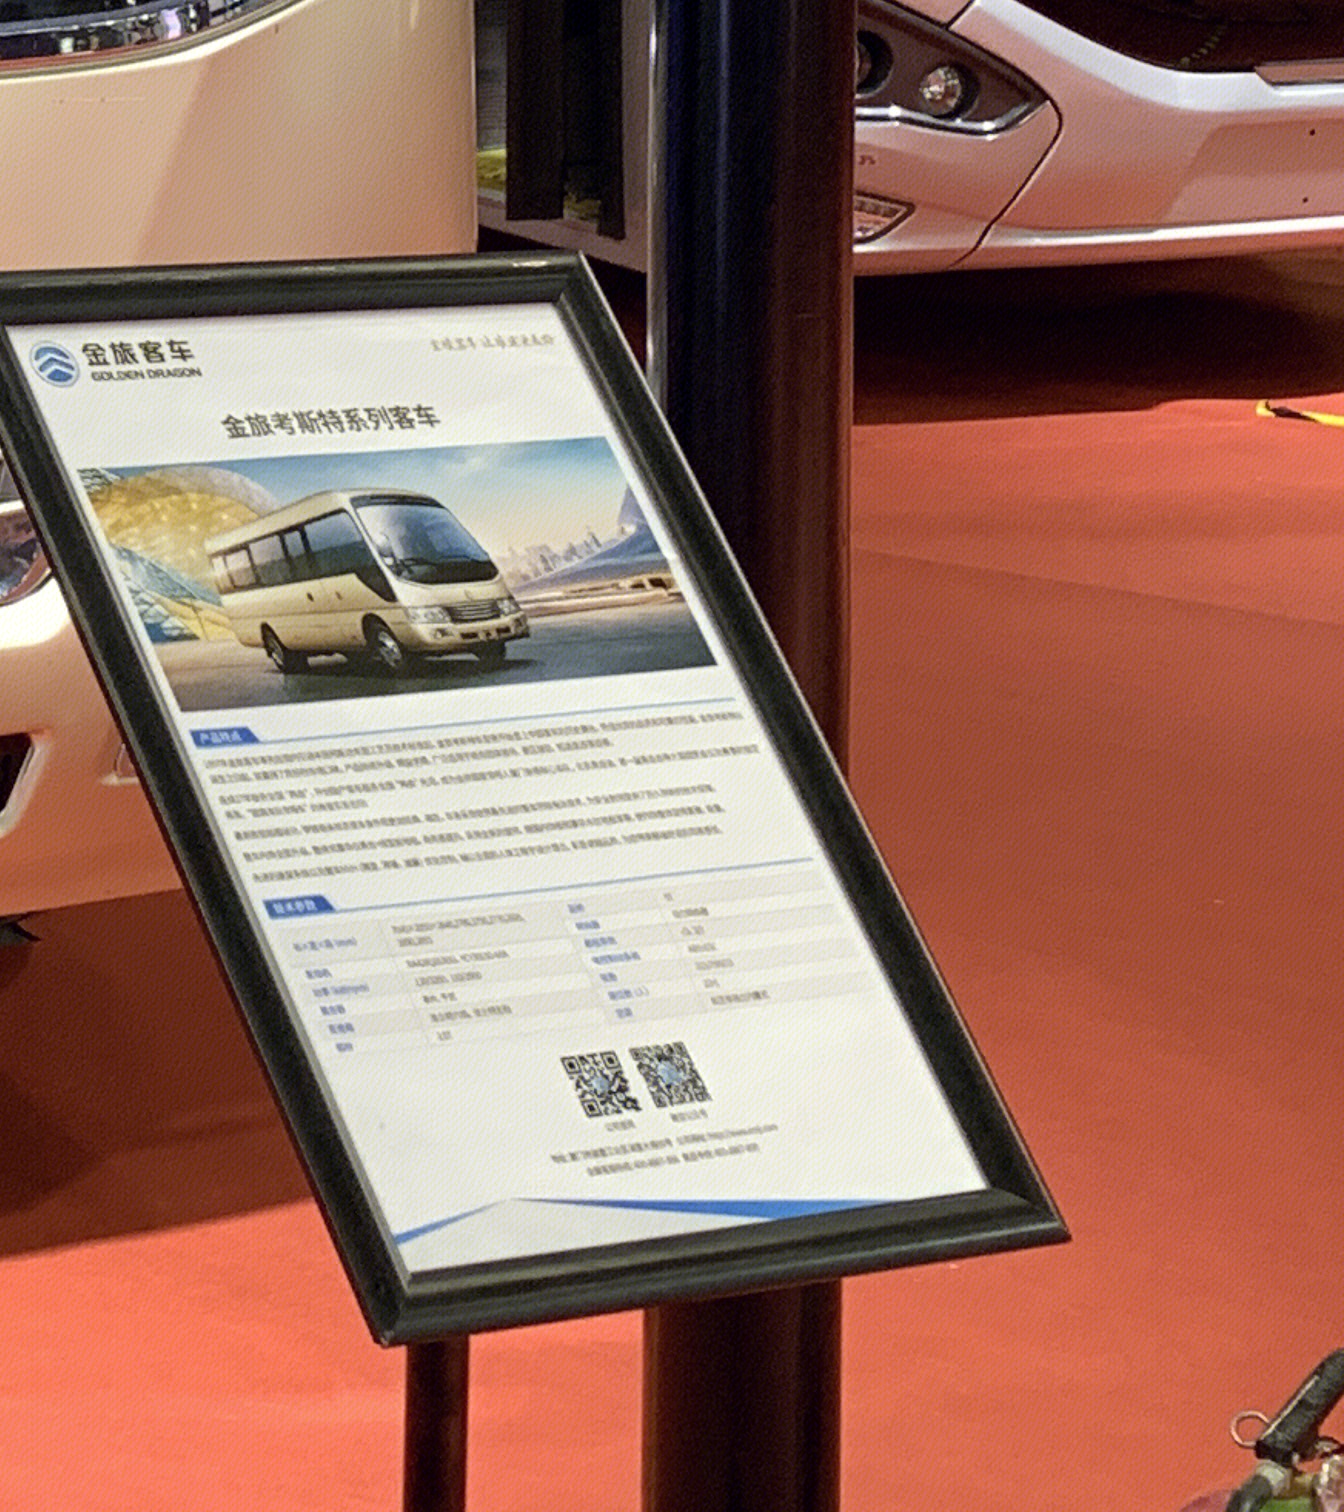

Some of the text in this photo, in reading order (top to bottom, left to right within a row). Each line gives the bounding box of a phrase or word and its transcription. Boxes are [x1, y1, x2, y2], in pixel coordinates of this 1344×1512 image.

[82, 339, 195, 367] 金旅客车
[91, 367, 203, 381] GOLDEN DRAGON
[221, 403, 441, 439] 金旅考斯特系列客车
